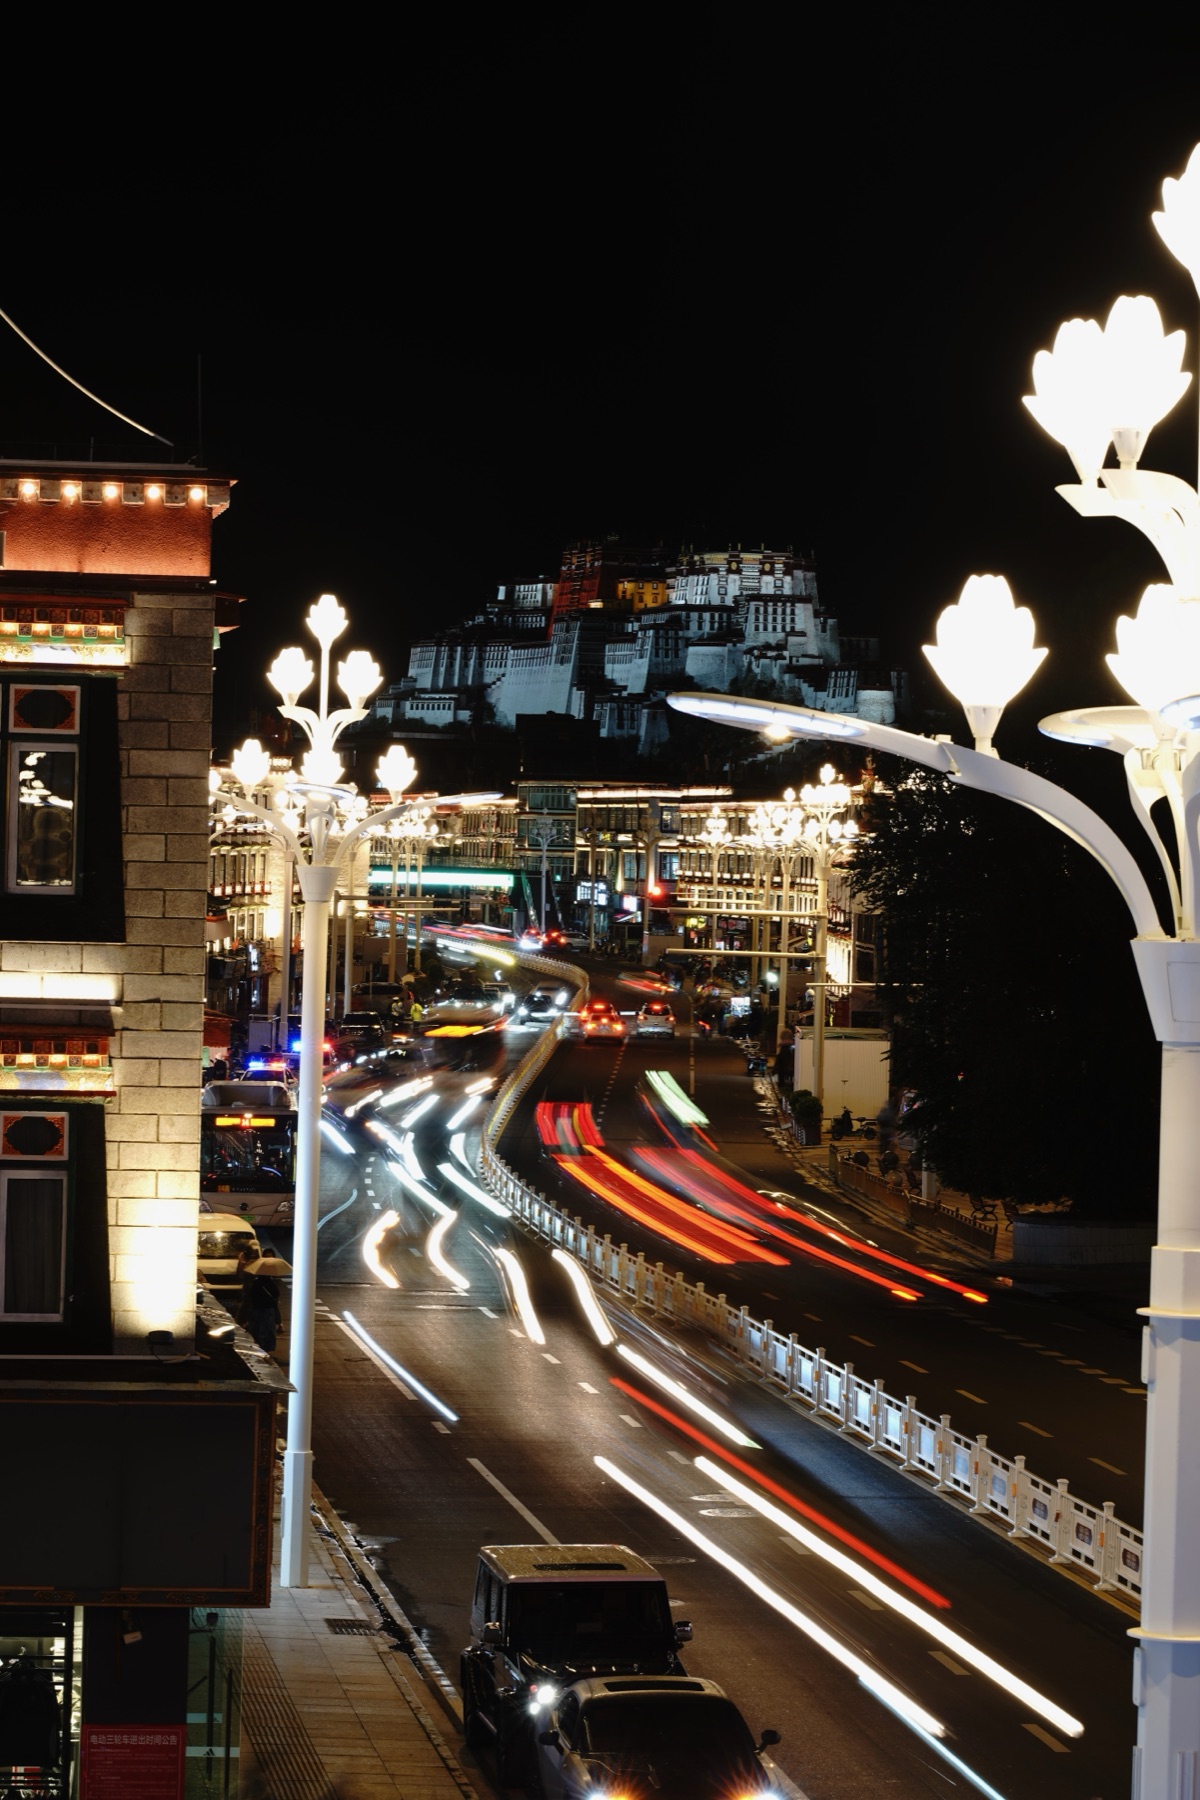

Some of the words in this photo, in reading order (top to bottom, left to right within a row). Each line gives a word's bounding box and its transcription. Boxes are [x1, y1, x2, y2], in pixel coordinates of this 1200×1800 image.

[90, 1734, 178, 1746] 电动三轮车进出时间公告
